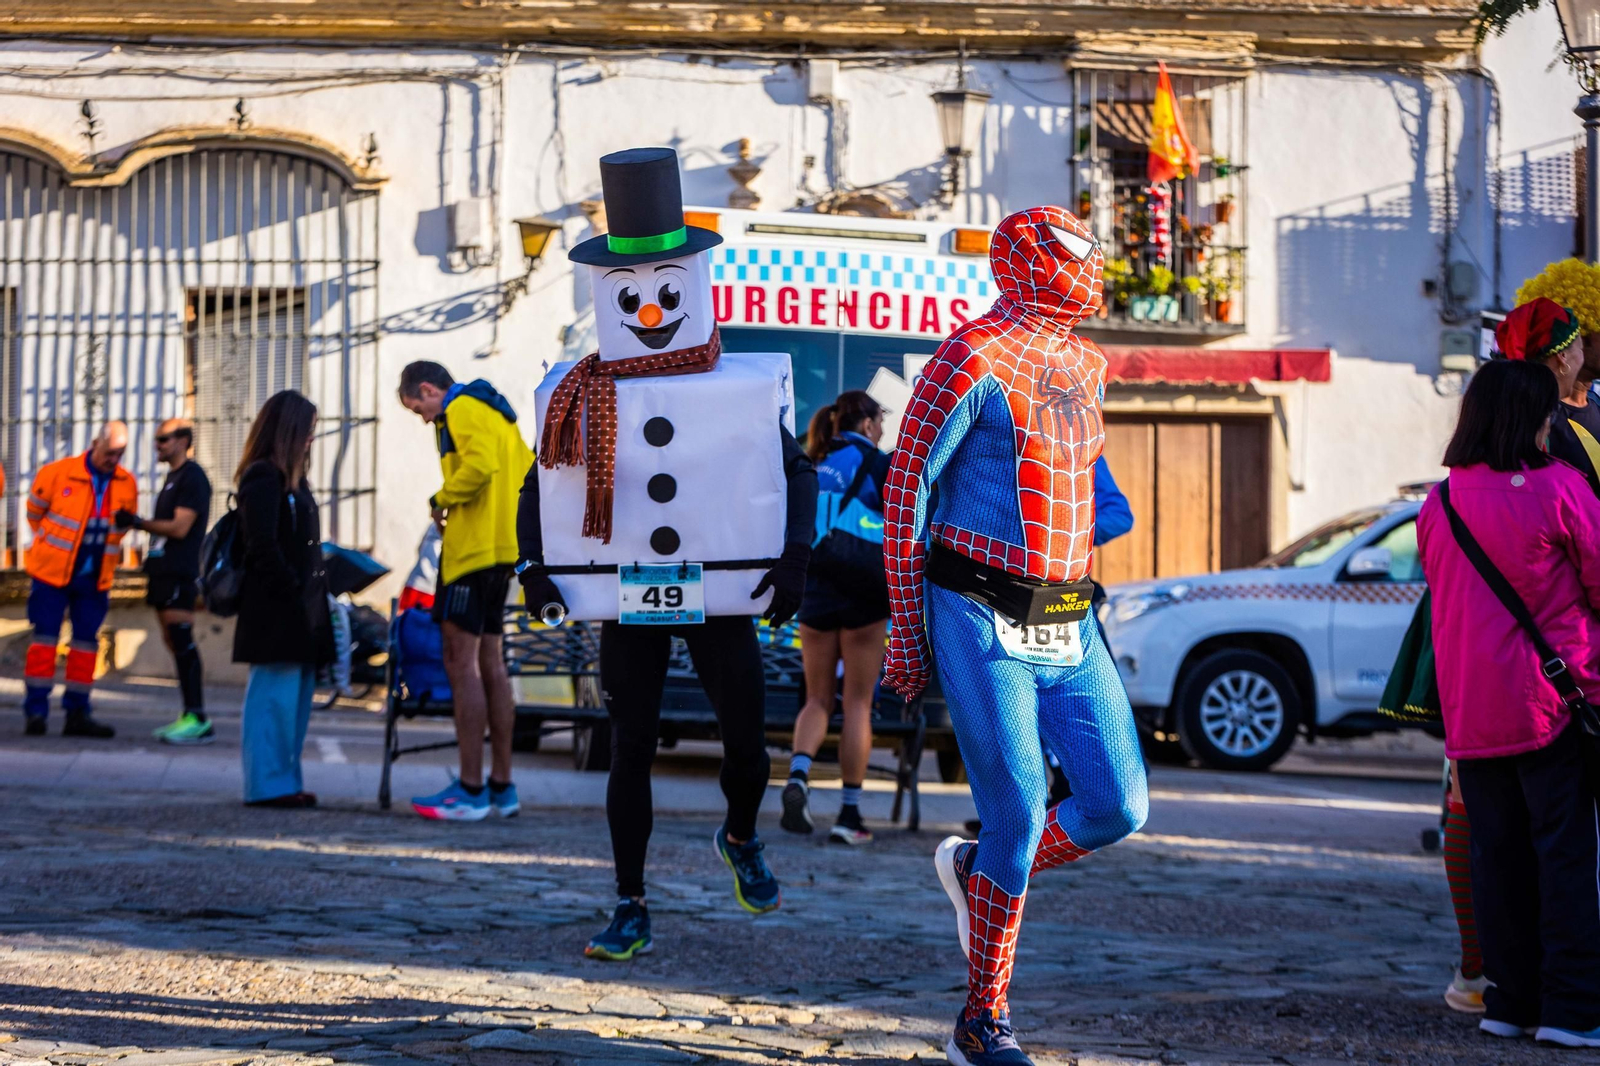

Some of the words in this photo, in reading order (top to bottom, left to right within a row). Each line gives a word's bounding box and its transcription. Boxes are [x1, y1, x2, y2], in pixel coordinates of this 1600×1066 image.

[711, 285, 969, 334] URGENCIAS
[642, 585, 683, 608] 49
[1045, 600, 1091, 613] HANKER
[645, 614, 674, 622] cajasur
